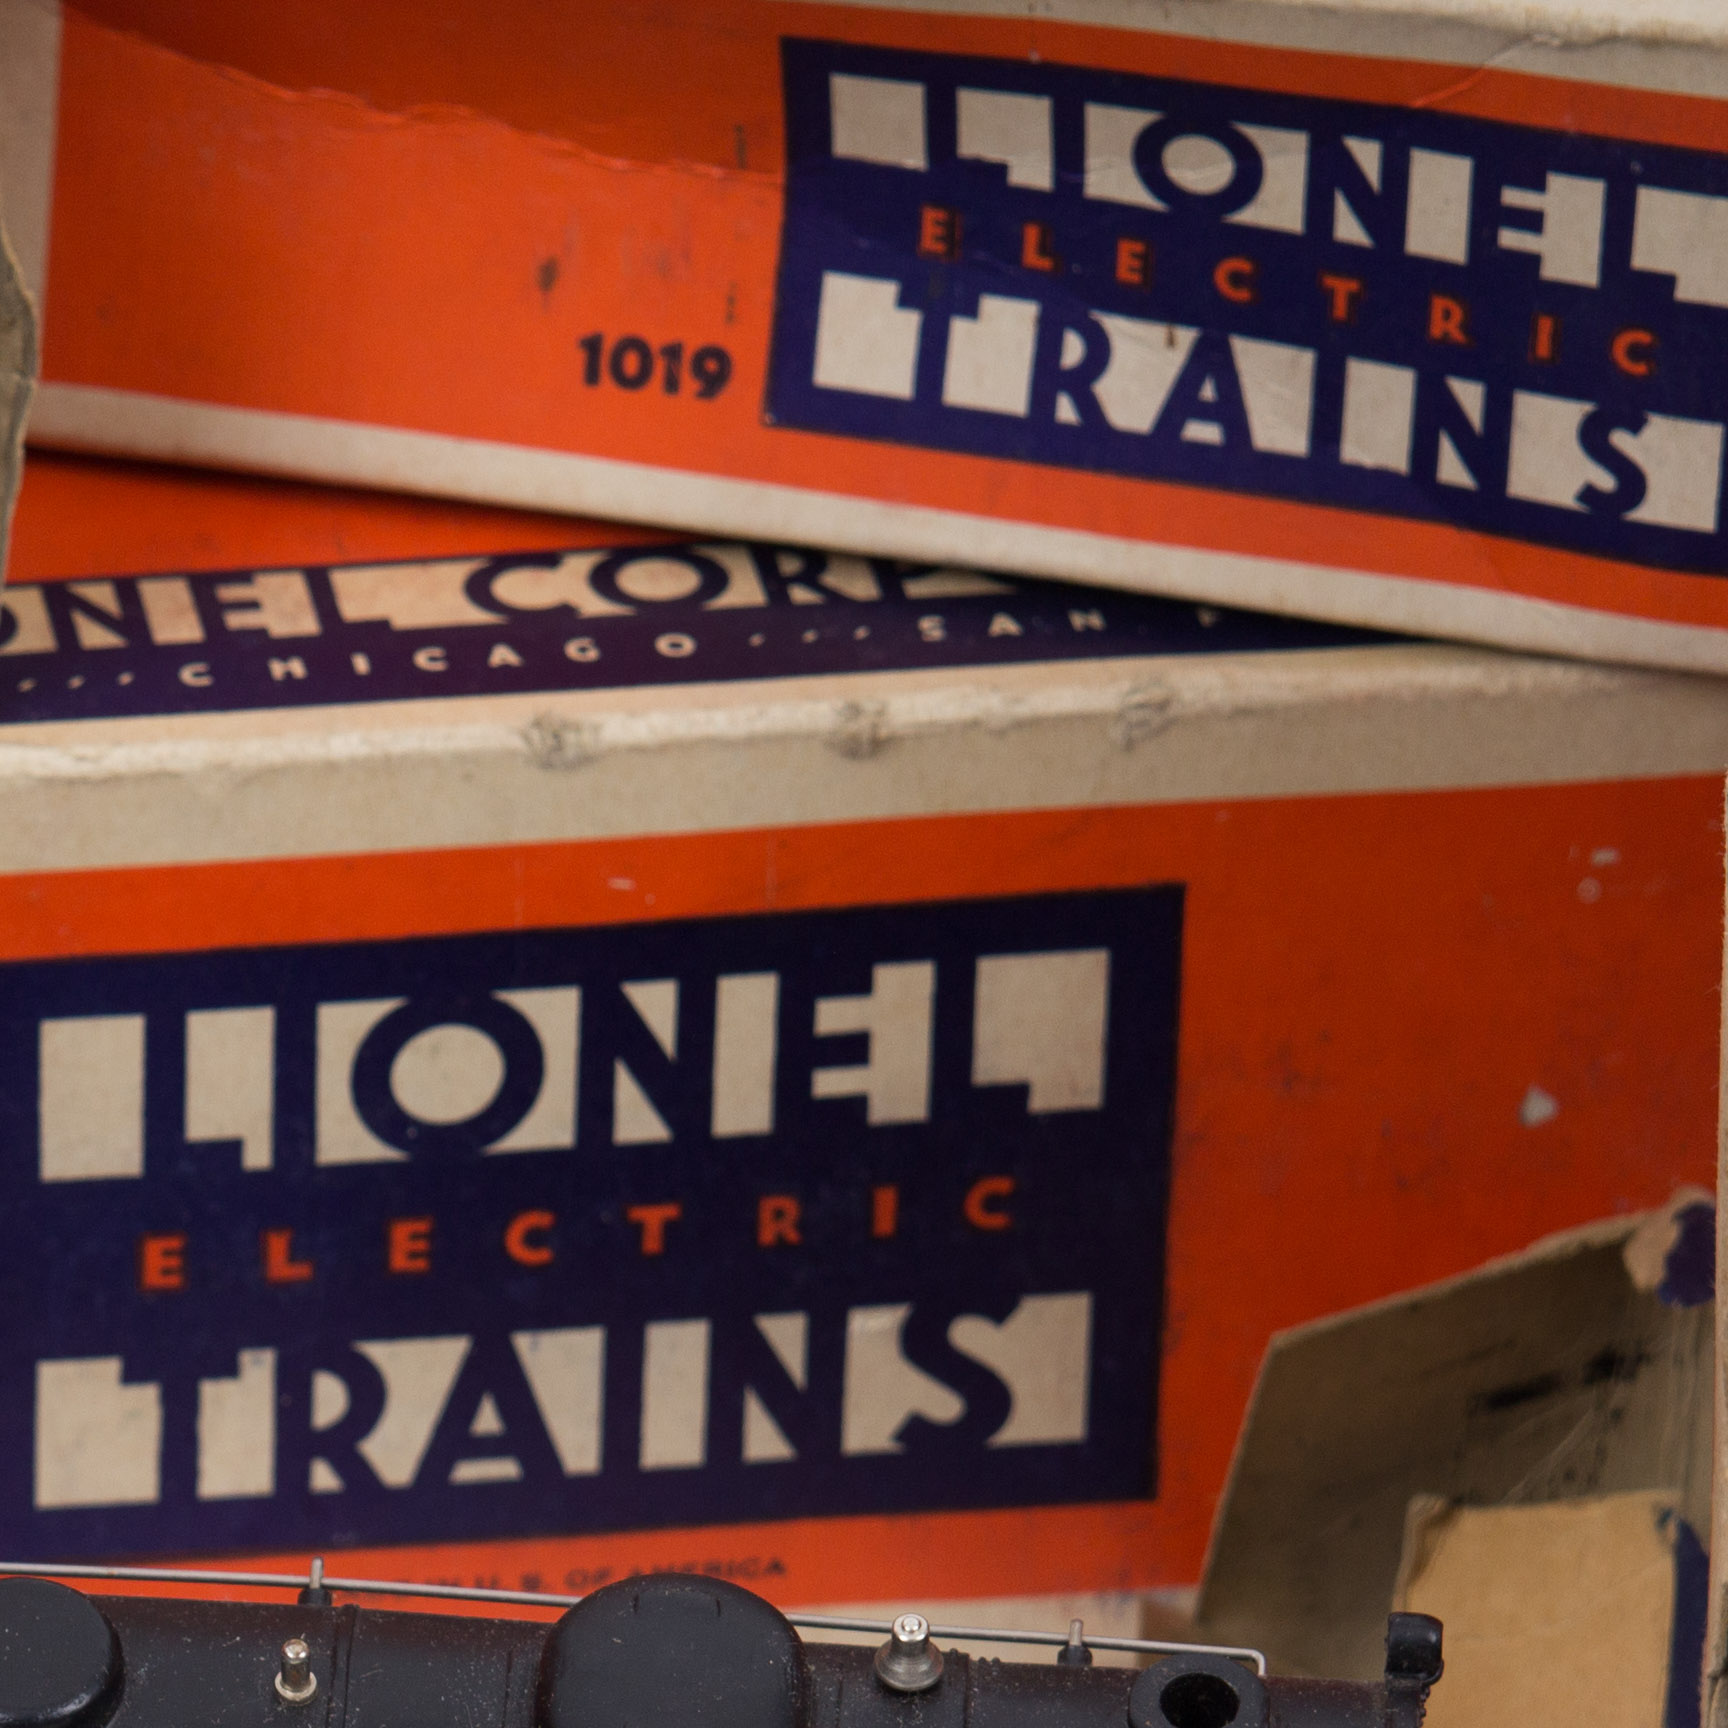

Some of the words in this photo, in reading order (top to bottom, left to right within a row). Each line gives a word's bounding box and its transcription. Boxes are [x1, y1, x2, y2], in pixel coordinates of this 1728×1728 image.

[926, 85, 1677, 303] LIONEL
[577, 331, 734, 401] 1019
[918, 206, 1658, 377] ELECTRIC
[896, 280, 1649, 520] TRAINS
[178, 630, 697, 690] CHICAGO
[917, 608, 1107, 642] SAN
[143, 950, 1033, 1176] LIONEL
[137, 1176, 1018, 1295] ELECTRIC
[119, 1297, 1014, 1503] TRAINS
